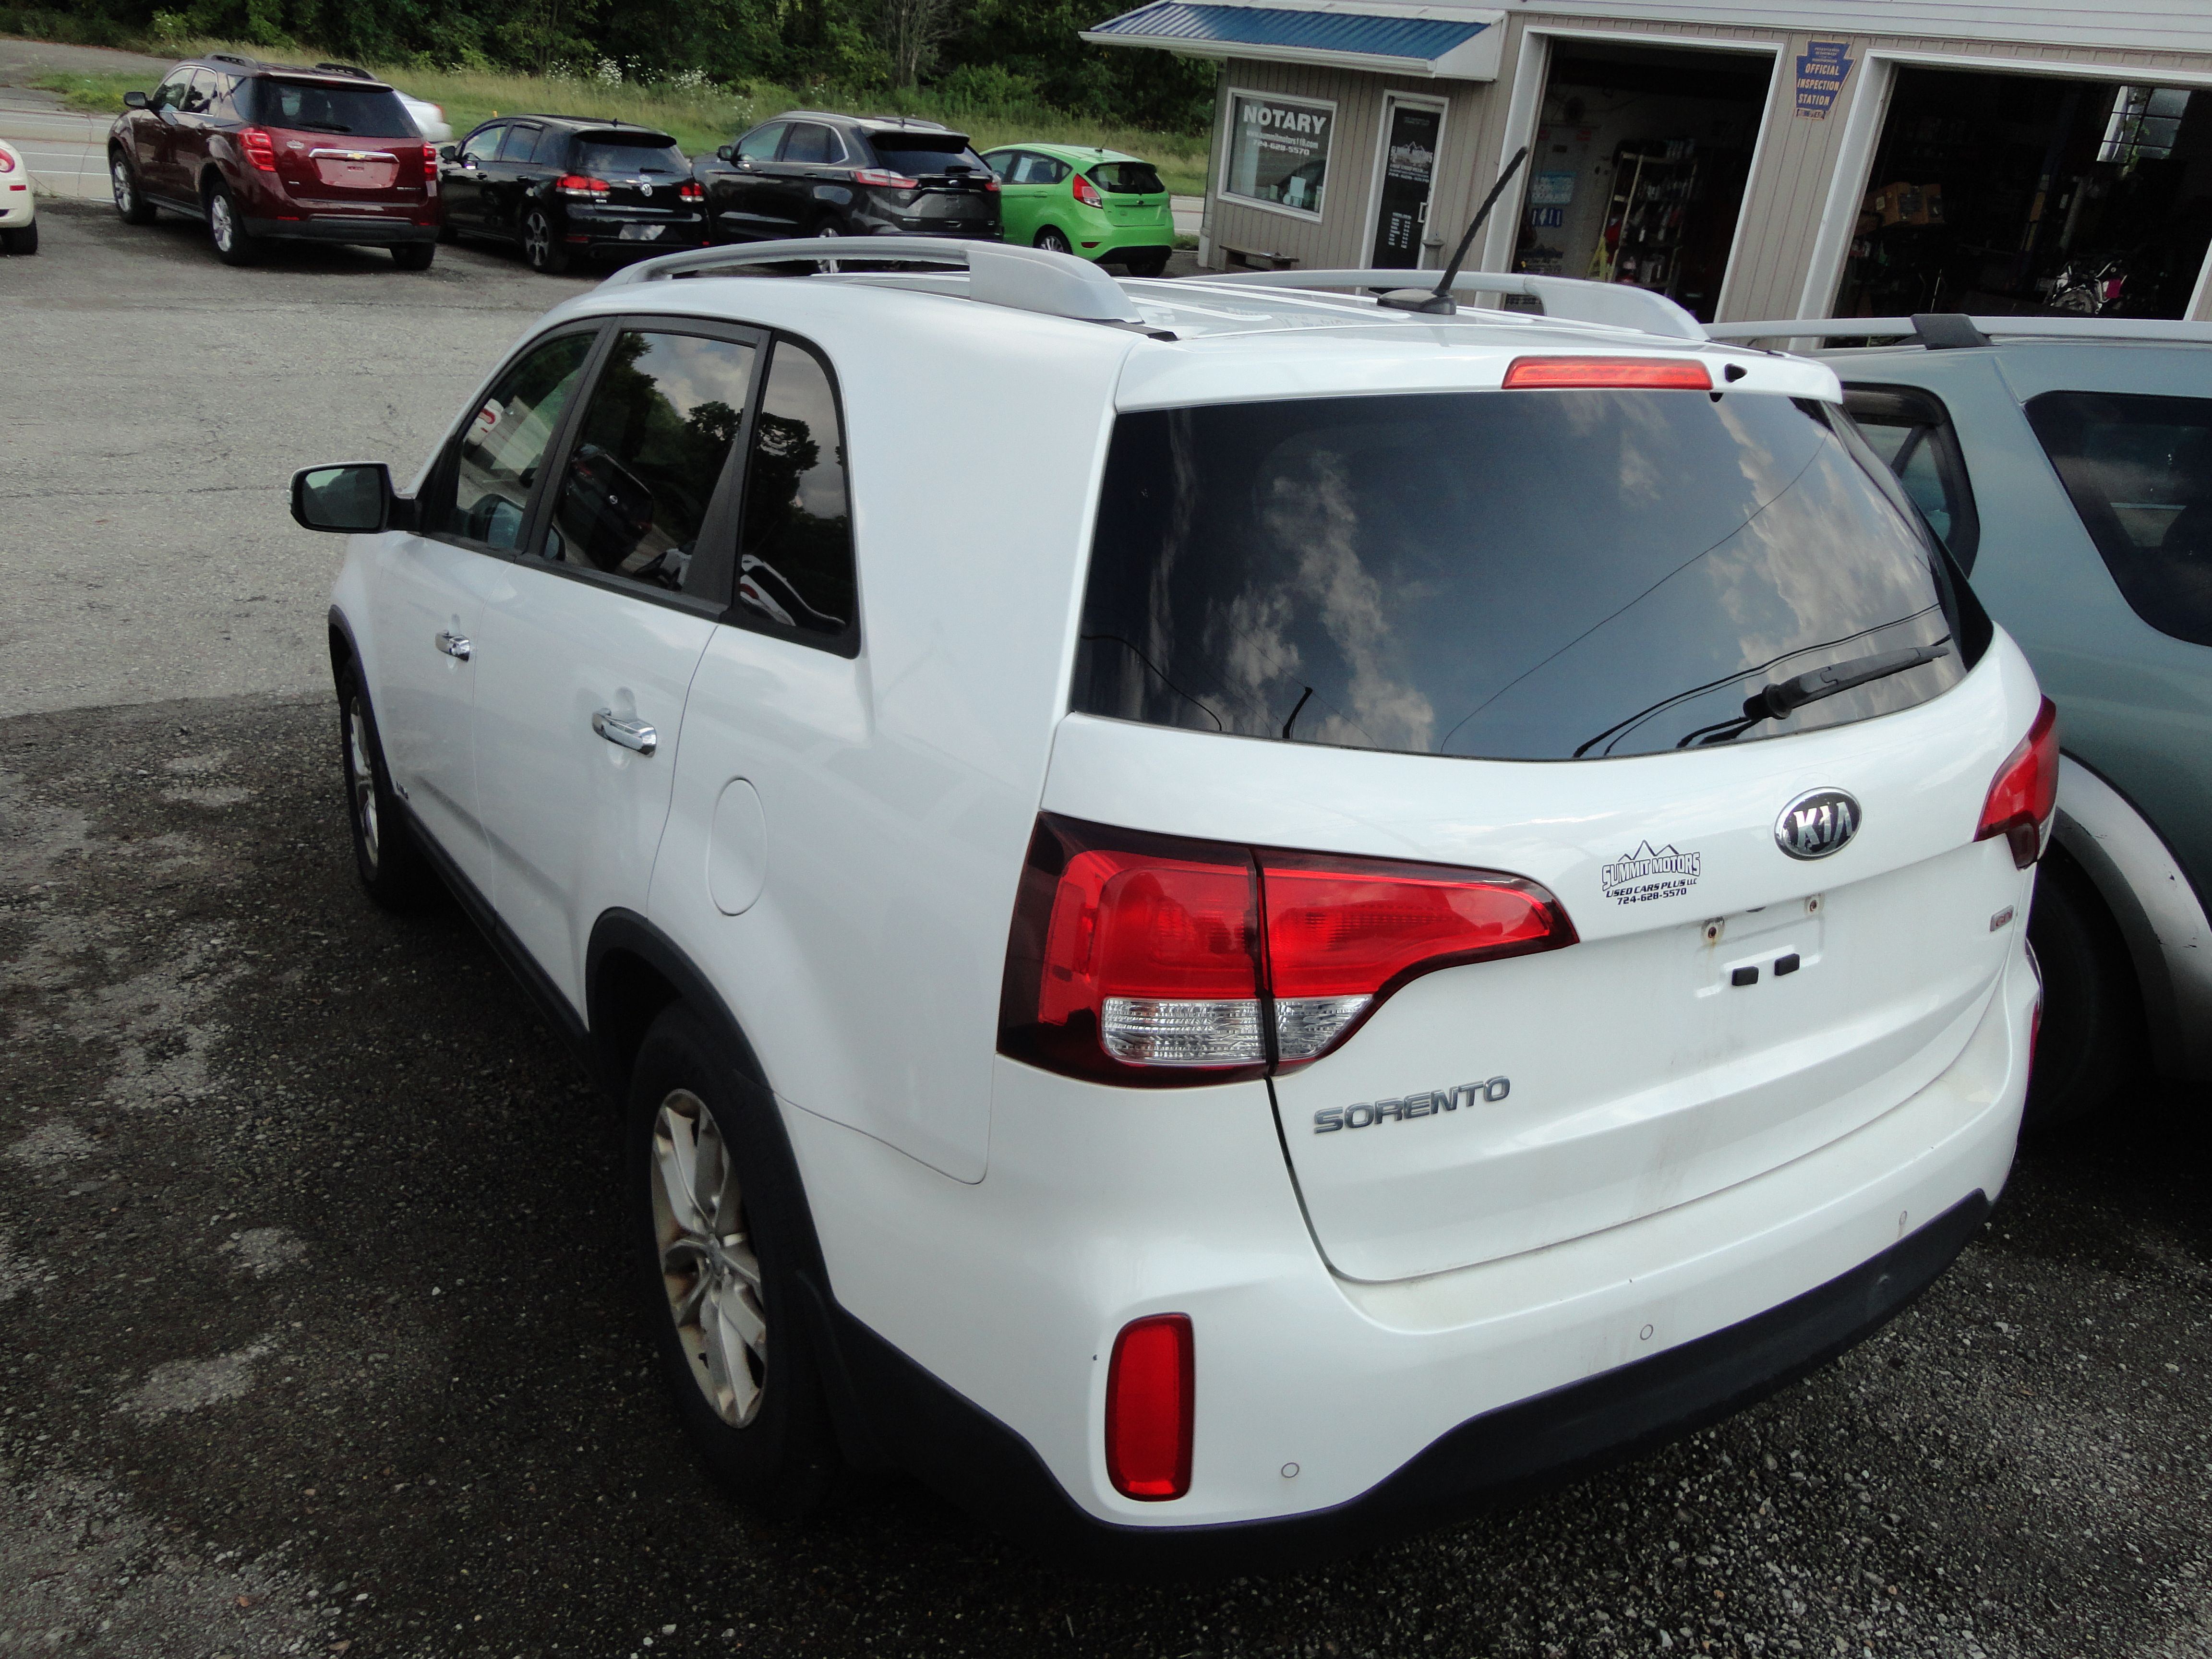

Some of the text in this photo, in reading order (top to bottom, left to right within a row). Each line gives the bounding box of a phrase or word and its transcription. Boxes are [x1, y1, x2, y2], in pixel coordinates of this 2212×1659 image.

[1805, 63, 1839, 75] OFFICIAL
[1797, 78, 1840, 91] INSPECTION
[1798, 94, 1830, 105] STATION
[1244, 105, 1327, 134] NOTARY
[1793, 801, 1852, 851] KIA
[1602, 852, 1701, 891] SUMMIT MOTORS
[1606, 888, 1632, 898] USED
[1634, 883, 1660, 893] CARS
[1660, 878, 1686, 889] PLUS
[1617, 888, 1687, 905] 724-628-5570
[1314, 1075, 1511, 1134] SORENTO
